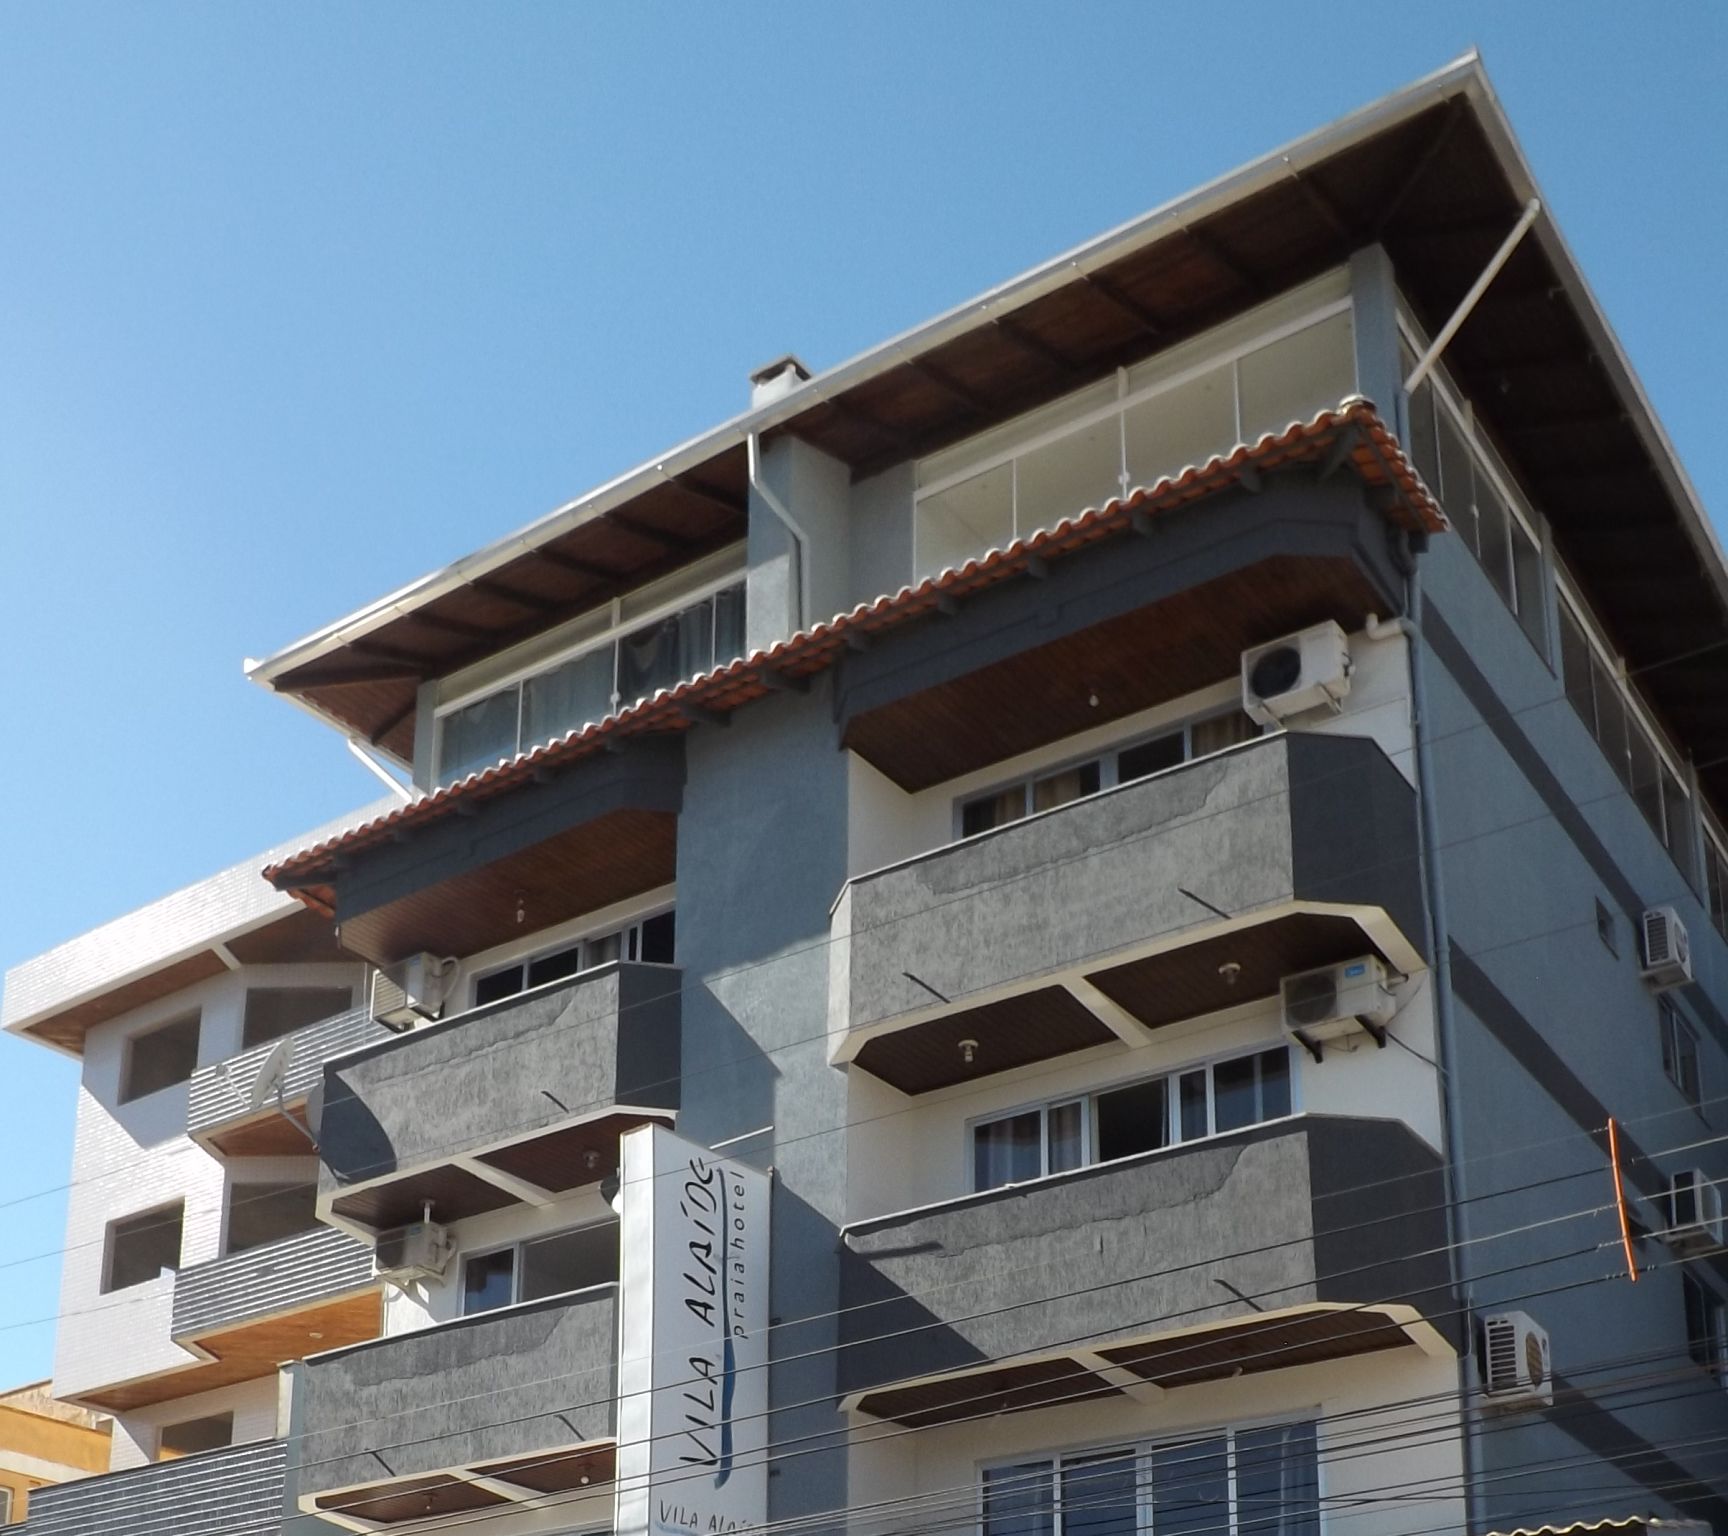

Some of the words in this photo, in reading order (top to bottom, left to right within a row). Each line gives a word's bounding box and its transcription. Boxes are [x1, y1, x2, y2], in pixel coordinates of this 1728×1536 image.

[679, 1156, 718, 1328] ALAÍDE
[729, 1171, 746, 1250] hotel
[730, 1262, 749, 1340] praia
[678, 1356, 719, 1466] VILA
[659, 1499, 699, 1529] VILA
